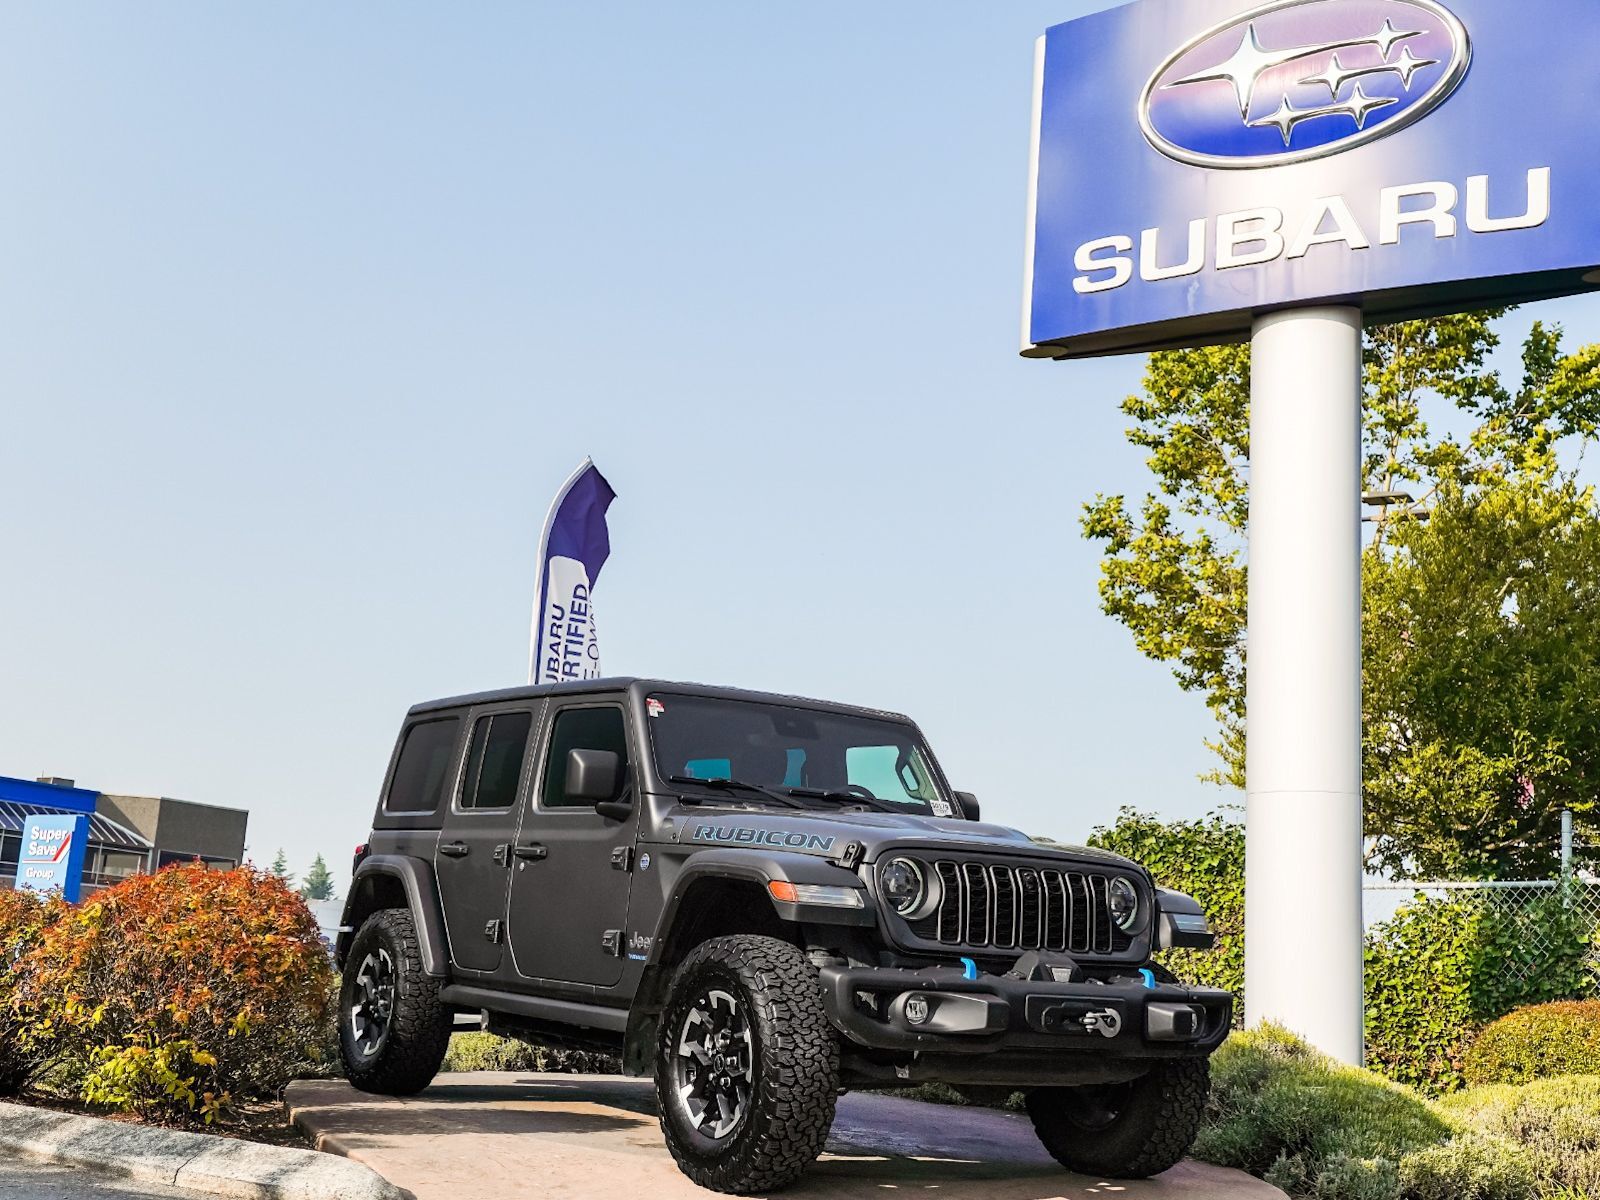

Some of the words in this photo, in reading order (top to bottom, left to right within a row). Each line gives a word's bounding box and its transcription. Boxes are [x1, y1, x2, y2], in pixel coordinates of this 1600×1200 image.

[1072, 166, 1551, 294] SUBARU
[546, 604, 565, 682] UBARU
[561, 584, 587, 681] RTIFIED
[28, 841, 58, 856] Save
[31, 826, 68, 843] Super
[693, 824, 836, 852] RUBICON
[26, 867, 54, 880] Group
